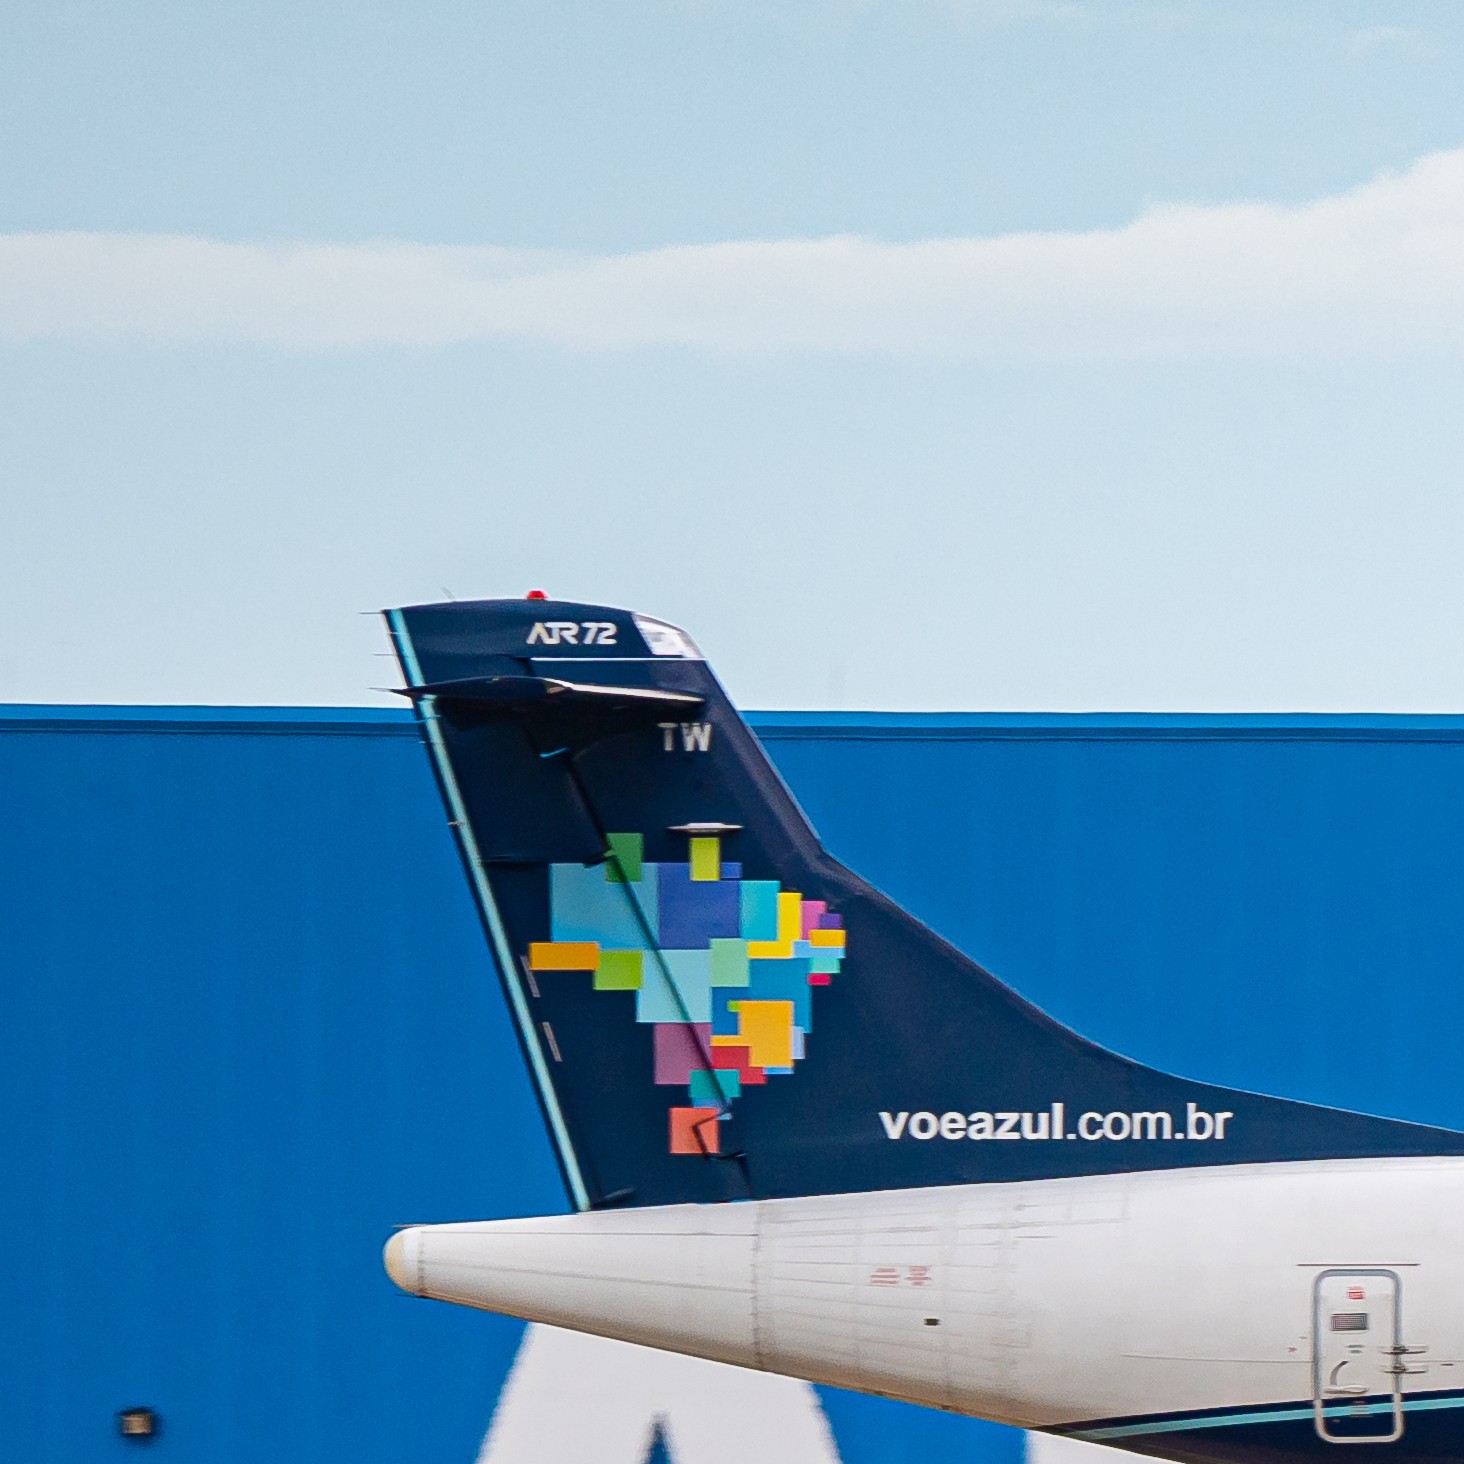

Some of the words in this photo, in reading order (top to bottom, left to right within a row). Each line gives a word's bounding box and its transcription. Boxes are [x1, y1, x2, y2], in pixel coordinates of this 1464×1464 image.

[526, 622, 579, 645] ATR
[581, 622, 617, 645] 72
[657, 722, 712, 751] TW
[878, 1102, 1233, 1140] voeazul.com.br
